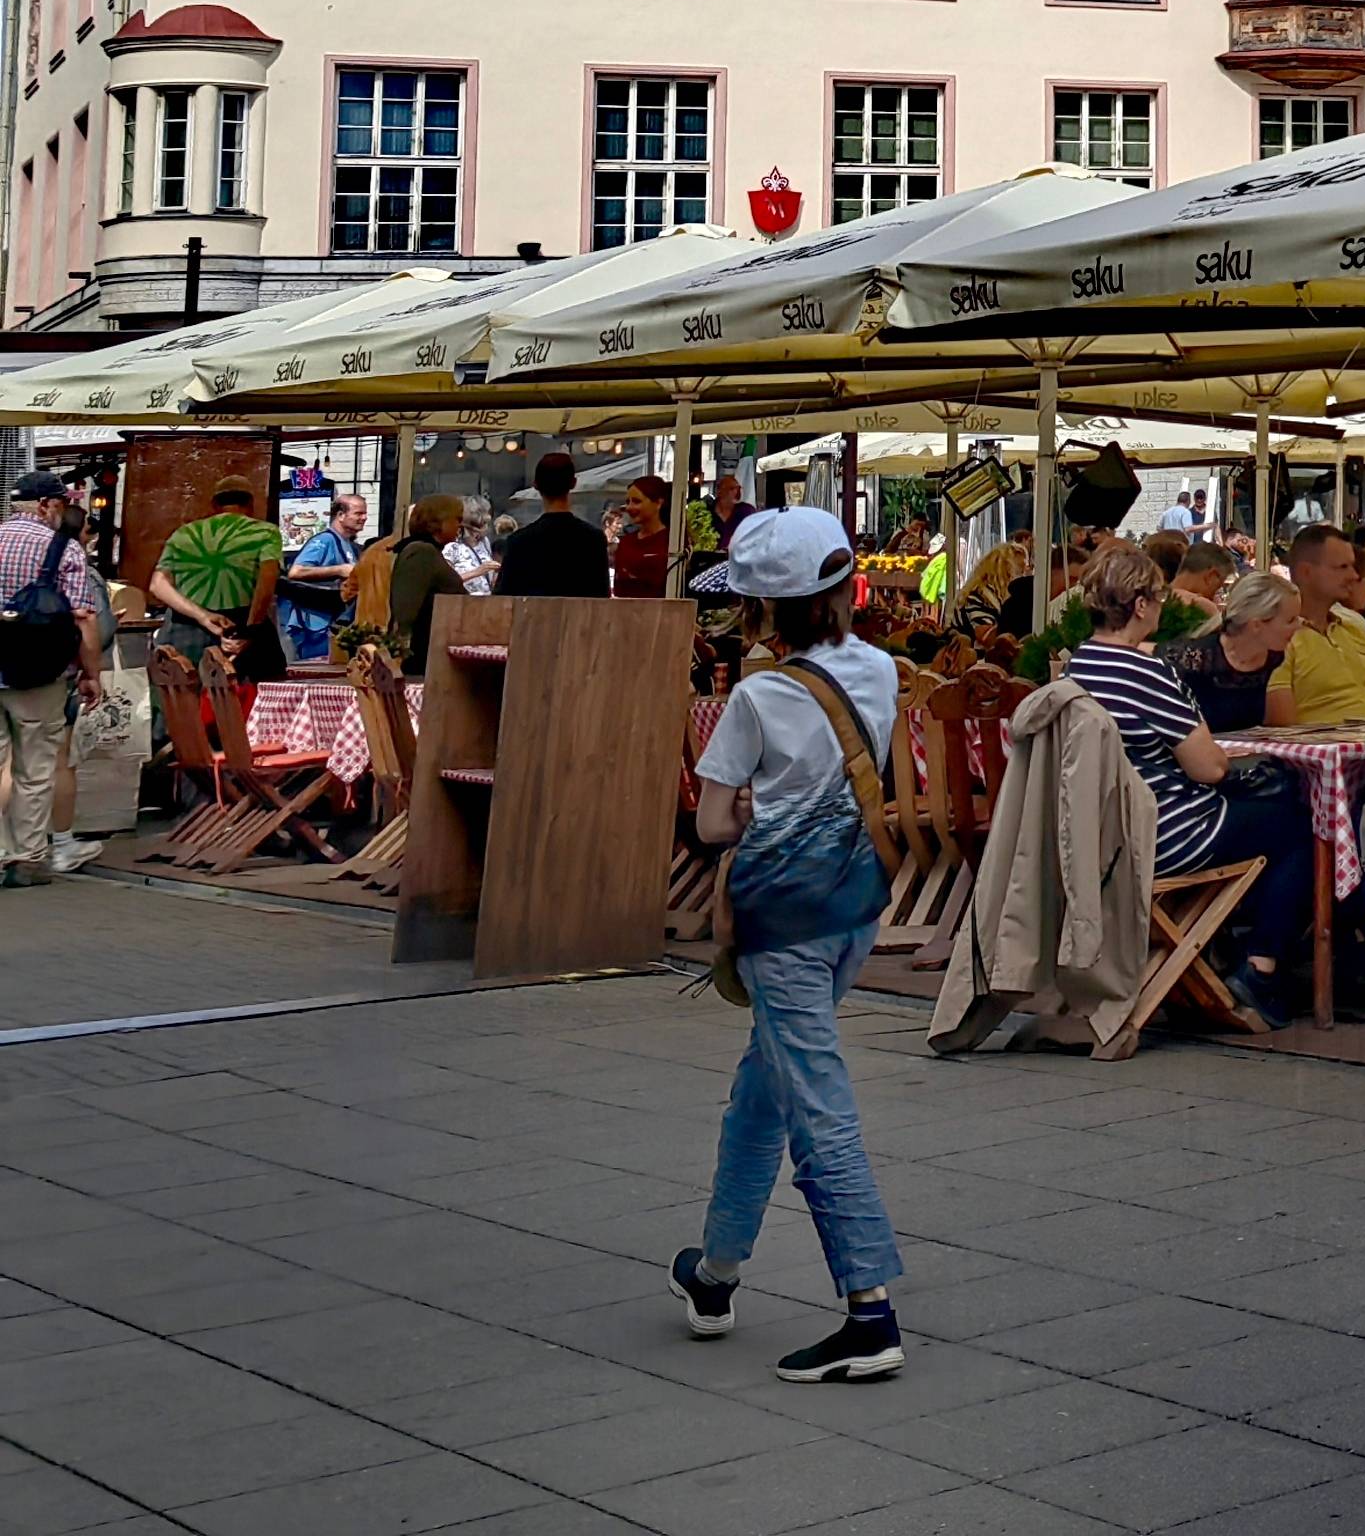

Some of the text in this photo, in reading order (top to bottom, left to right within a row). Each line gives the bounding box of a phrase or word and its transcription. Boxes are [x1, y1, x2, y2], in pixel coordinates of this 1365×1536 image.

[1071, 255, 1124, 299] saku
[1195, 239, 1252, 285] saku
[782, 293, 825, 331] saku
[950, 275, 1001, 316] saku
[598, 319, 634, 355] saku
[682, 307, 723, 342] saku
[273, 352, 306, 383] saku
[340, 345, 372, 375] saku
[415, 336, 447, 367] saku
[510, 336, 552, 368] saku
[214, 363, 240, 395] saku
[85, 385, 116, 409] saku
